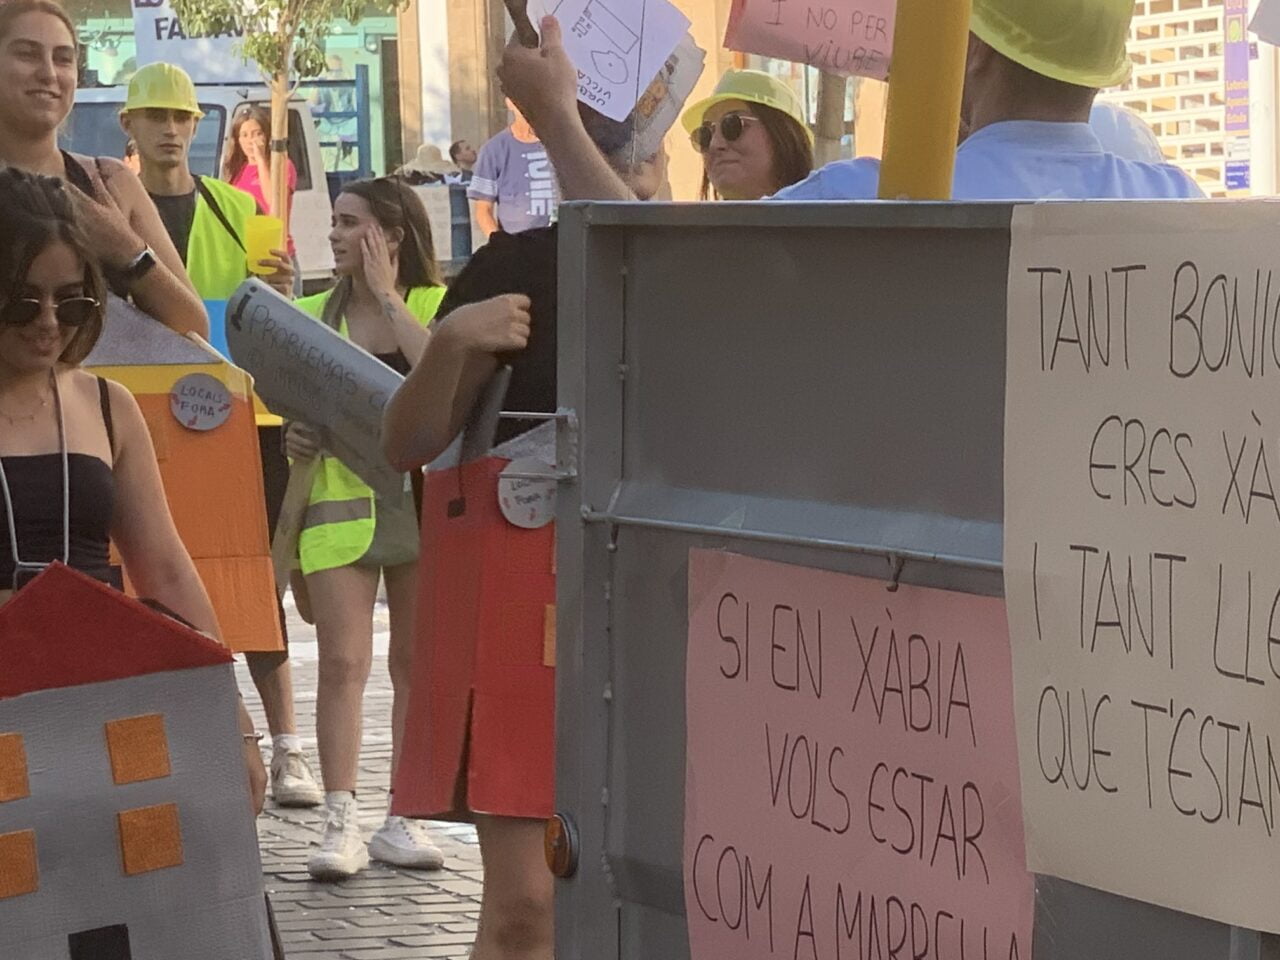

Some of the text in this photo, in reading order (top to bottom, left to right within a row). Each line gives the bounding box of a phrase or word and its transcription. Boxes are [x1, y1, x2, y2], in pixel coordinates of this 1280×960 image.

[806, 7, 838, 30] NO
[851, 10, 888, 42] PER
[1027, 264, 1147, 374] TANT
[1088, 414, 1197, 509] ERES
[1032, 541, 1042, 641] I
[1069, 544, 1187, 670] TANT
[716, 592, 977, 748] SI EN XÀBIA
[1036, 685, 1119, 794] QUE
[764, 723, 990, 885] VOLS ESTAR
[692, 833, 774, 953] COM
